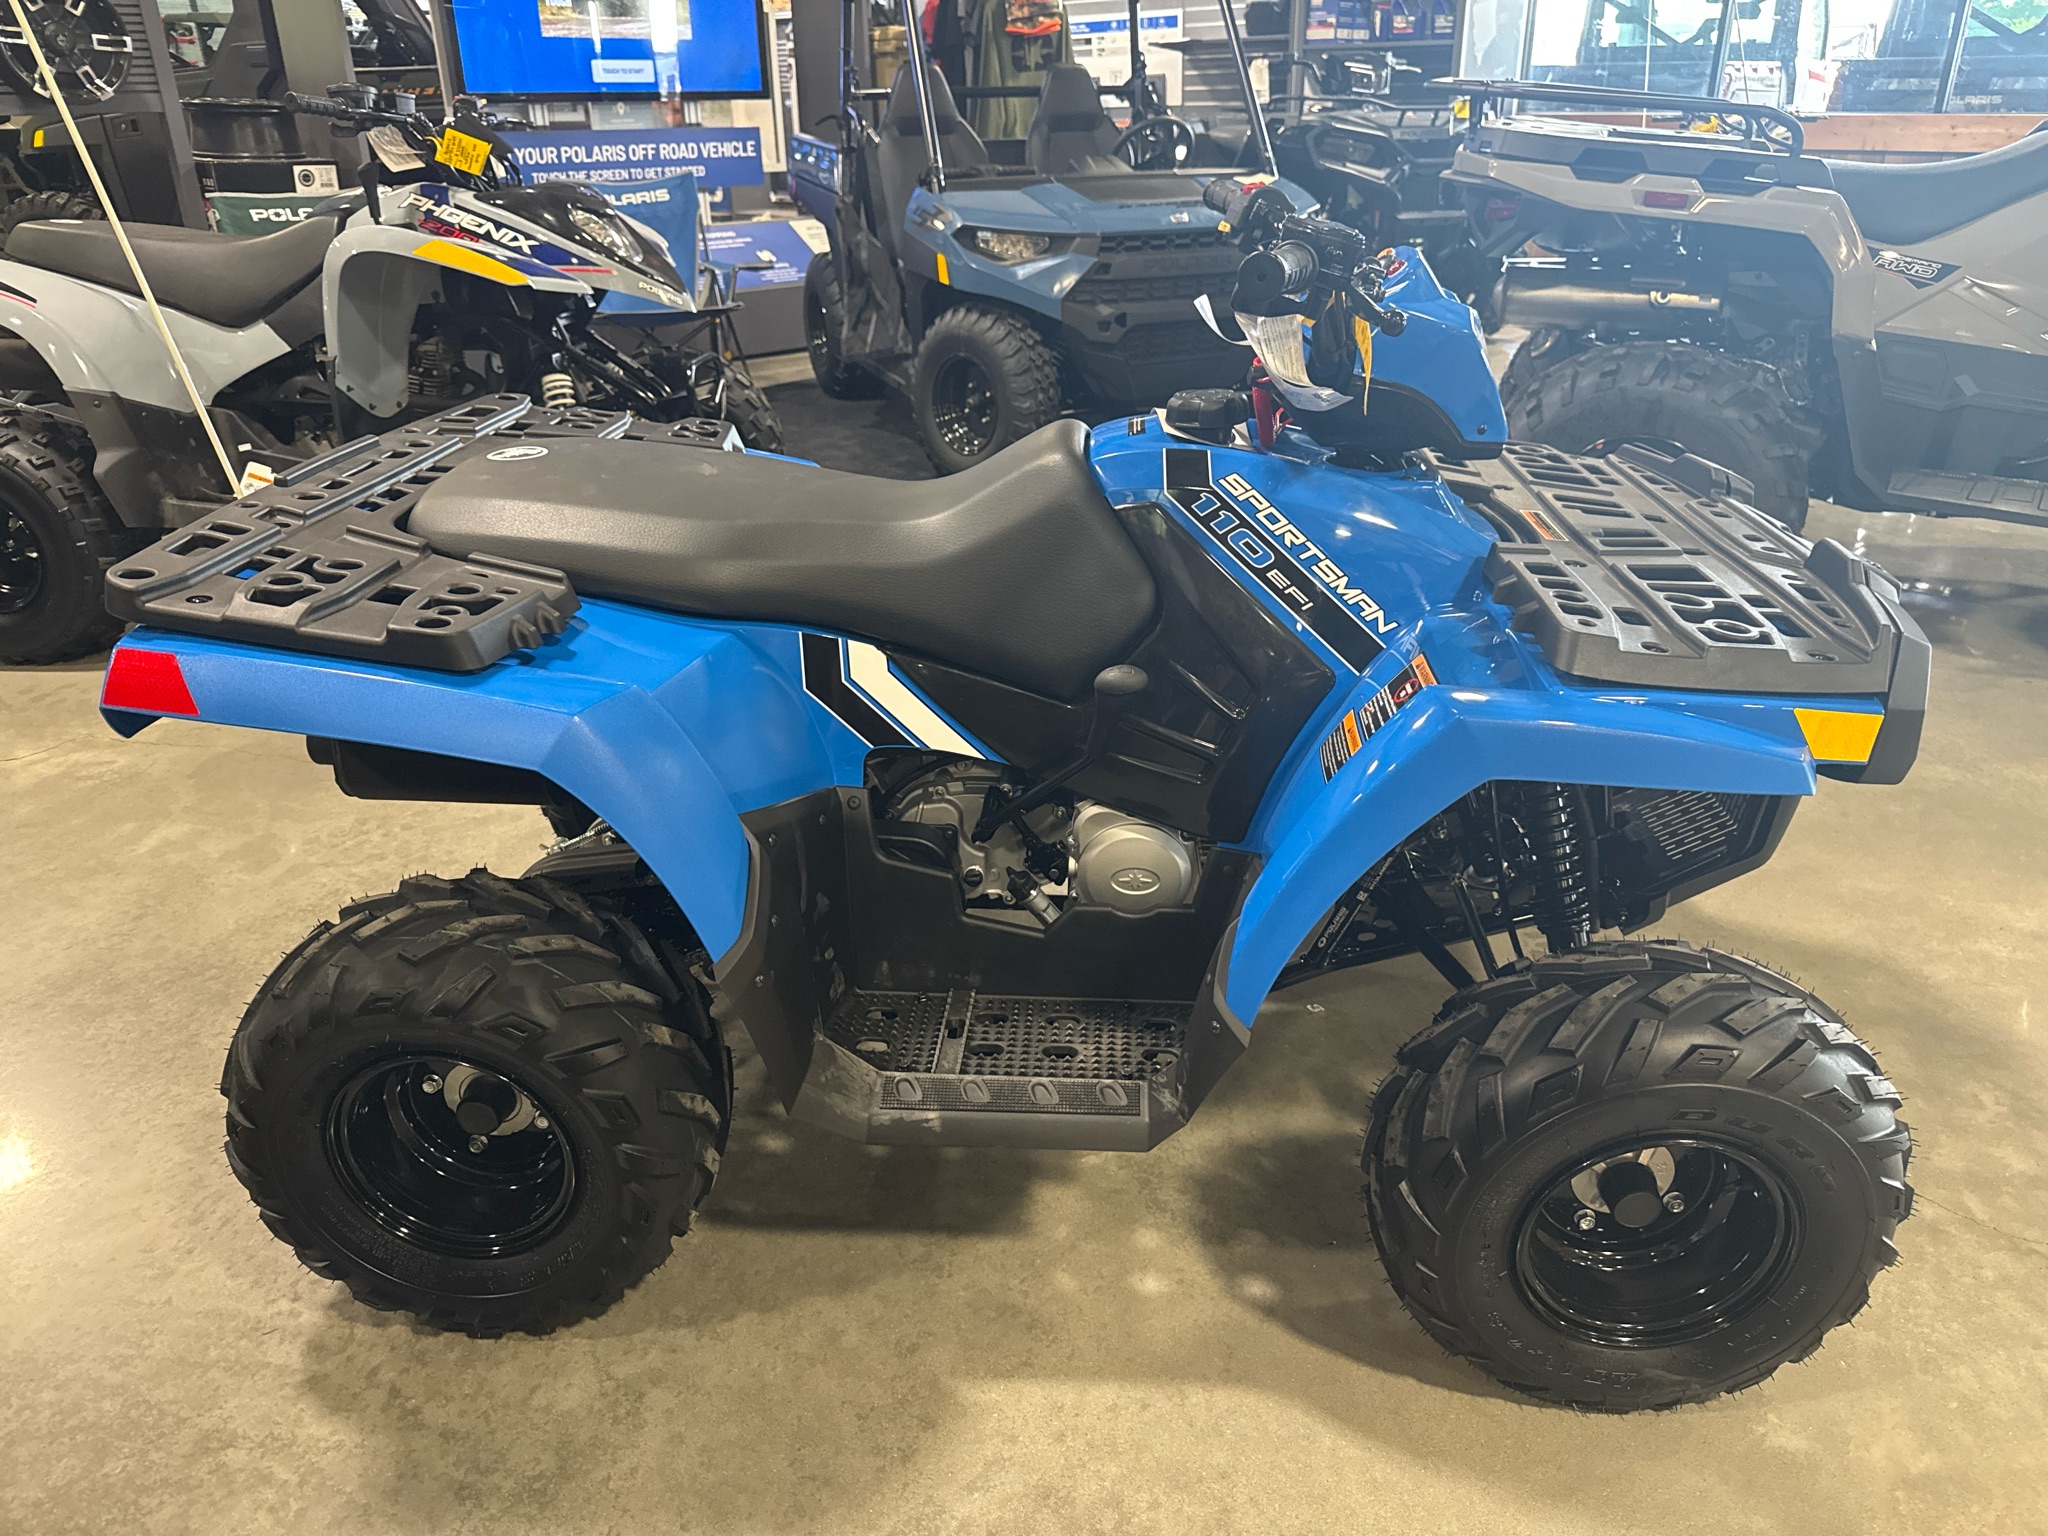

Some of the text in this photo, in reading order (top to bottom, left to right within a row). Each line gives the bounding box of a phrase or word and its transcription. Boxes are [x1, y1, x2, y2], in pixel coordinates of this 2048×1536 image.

[515, 140, 756, 165] YOUR POLARIS OFF ROAD VEHICLE
[589, 168, 629, 181] SCREEN
[630, 167, 643, 180] TO
[644, 167, 662, 179] GET
[398, 192, 540, 255] PHOENIX
[1872, 255, 1938, 278] AWD
[1190, 491, 1314, 610] 110 EFI
[1218, 472, 1400, 635] SPORTSMAN
[1323, 906, 1347, 938] POLARIS
